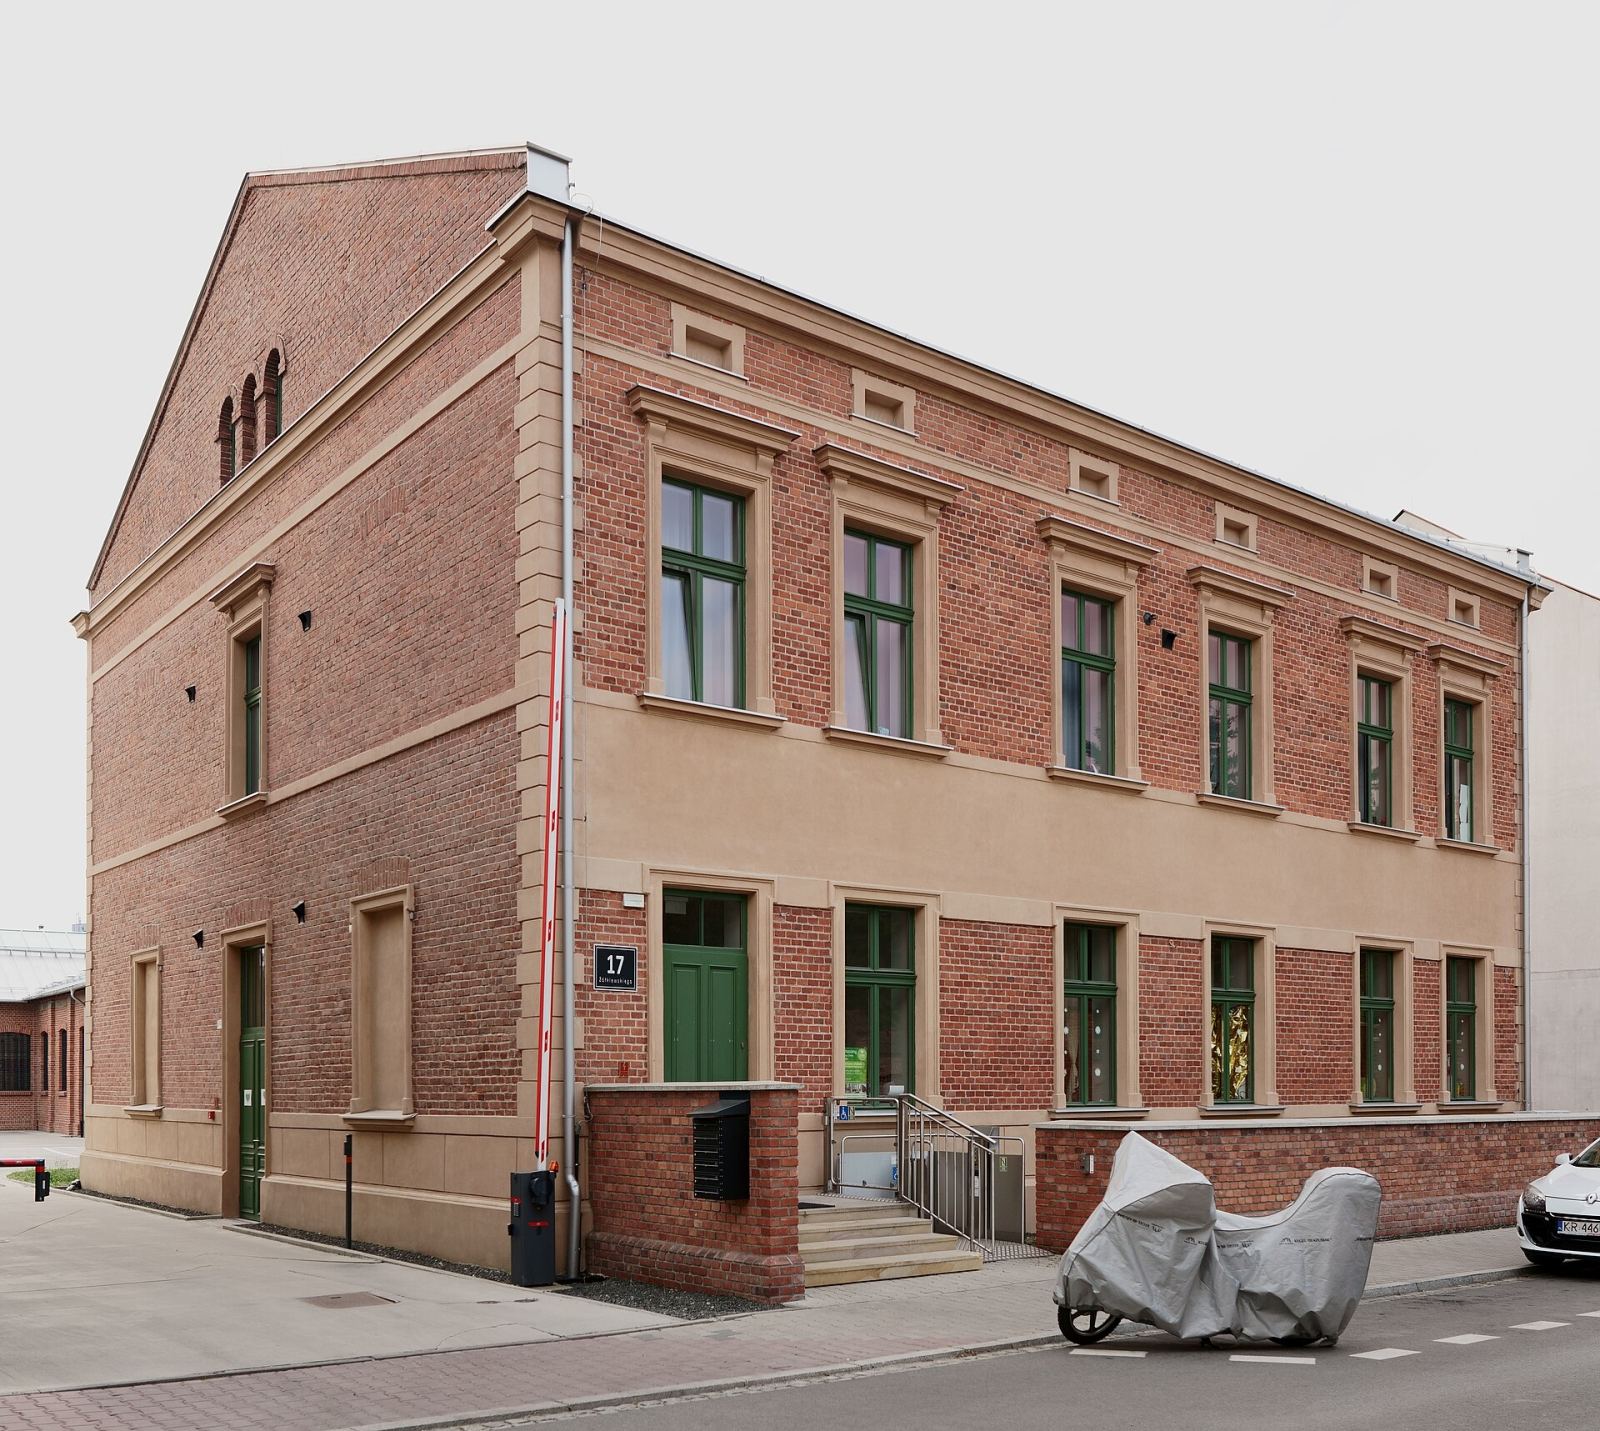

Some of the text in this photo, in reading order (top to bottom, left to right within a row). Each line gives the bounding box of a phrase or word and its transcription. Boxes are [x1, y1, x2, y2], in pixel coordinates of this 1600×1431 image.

[607, 954, 624, 974] 17
[1564, 1222, 1599, 1233] KR 446
